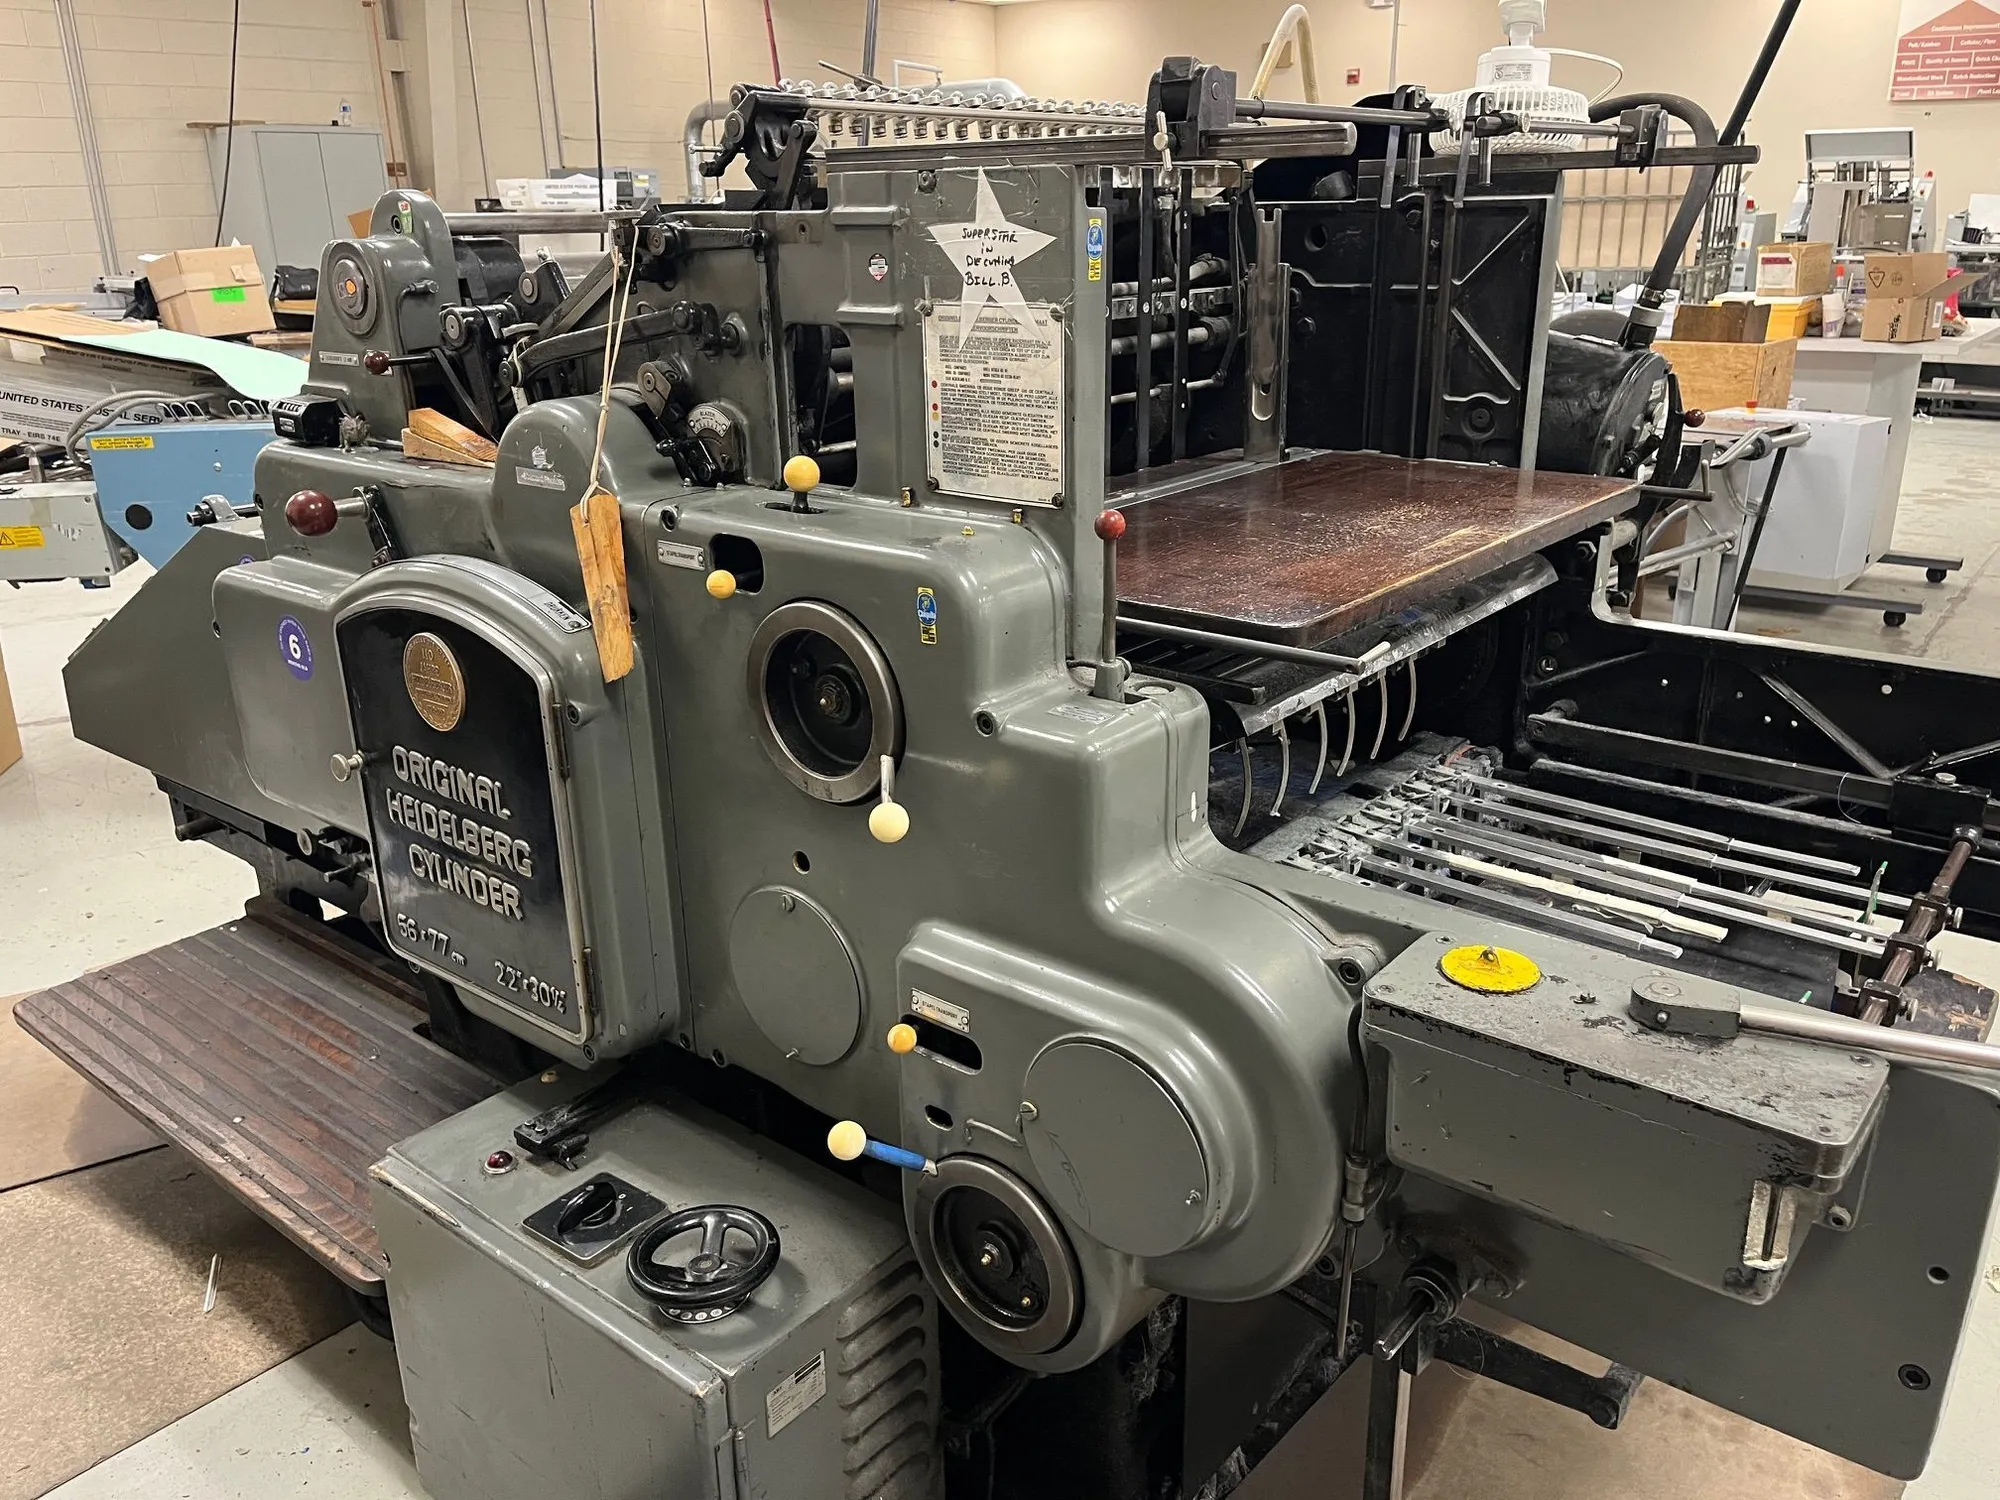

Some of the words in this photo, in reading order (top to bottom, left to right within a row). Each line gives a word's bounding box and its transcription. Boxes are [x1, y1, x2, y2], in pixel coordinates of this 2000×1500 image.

[0, 391, 39, 405] UNITED
[41, 398, 84, 413] STATES
[1, 427, 21, 436] TRAY
[288, 633, 302, 660] 6
[392, 744, 512, 820] ORIGINAL
[386, 788, 534, 879] HEIDELBERG
[409, 843, 524, 921] CYLINDER
